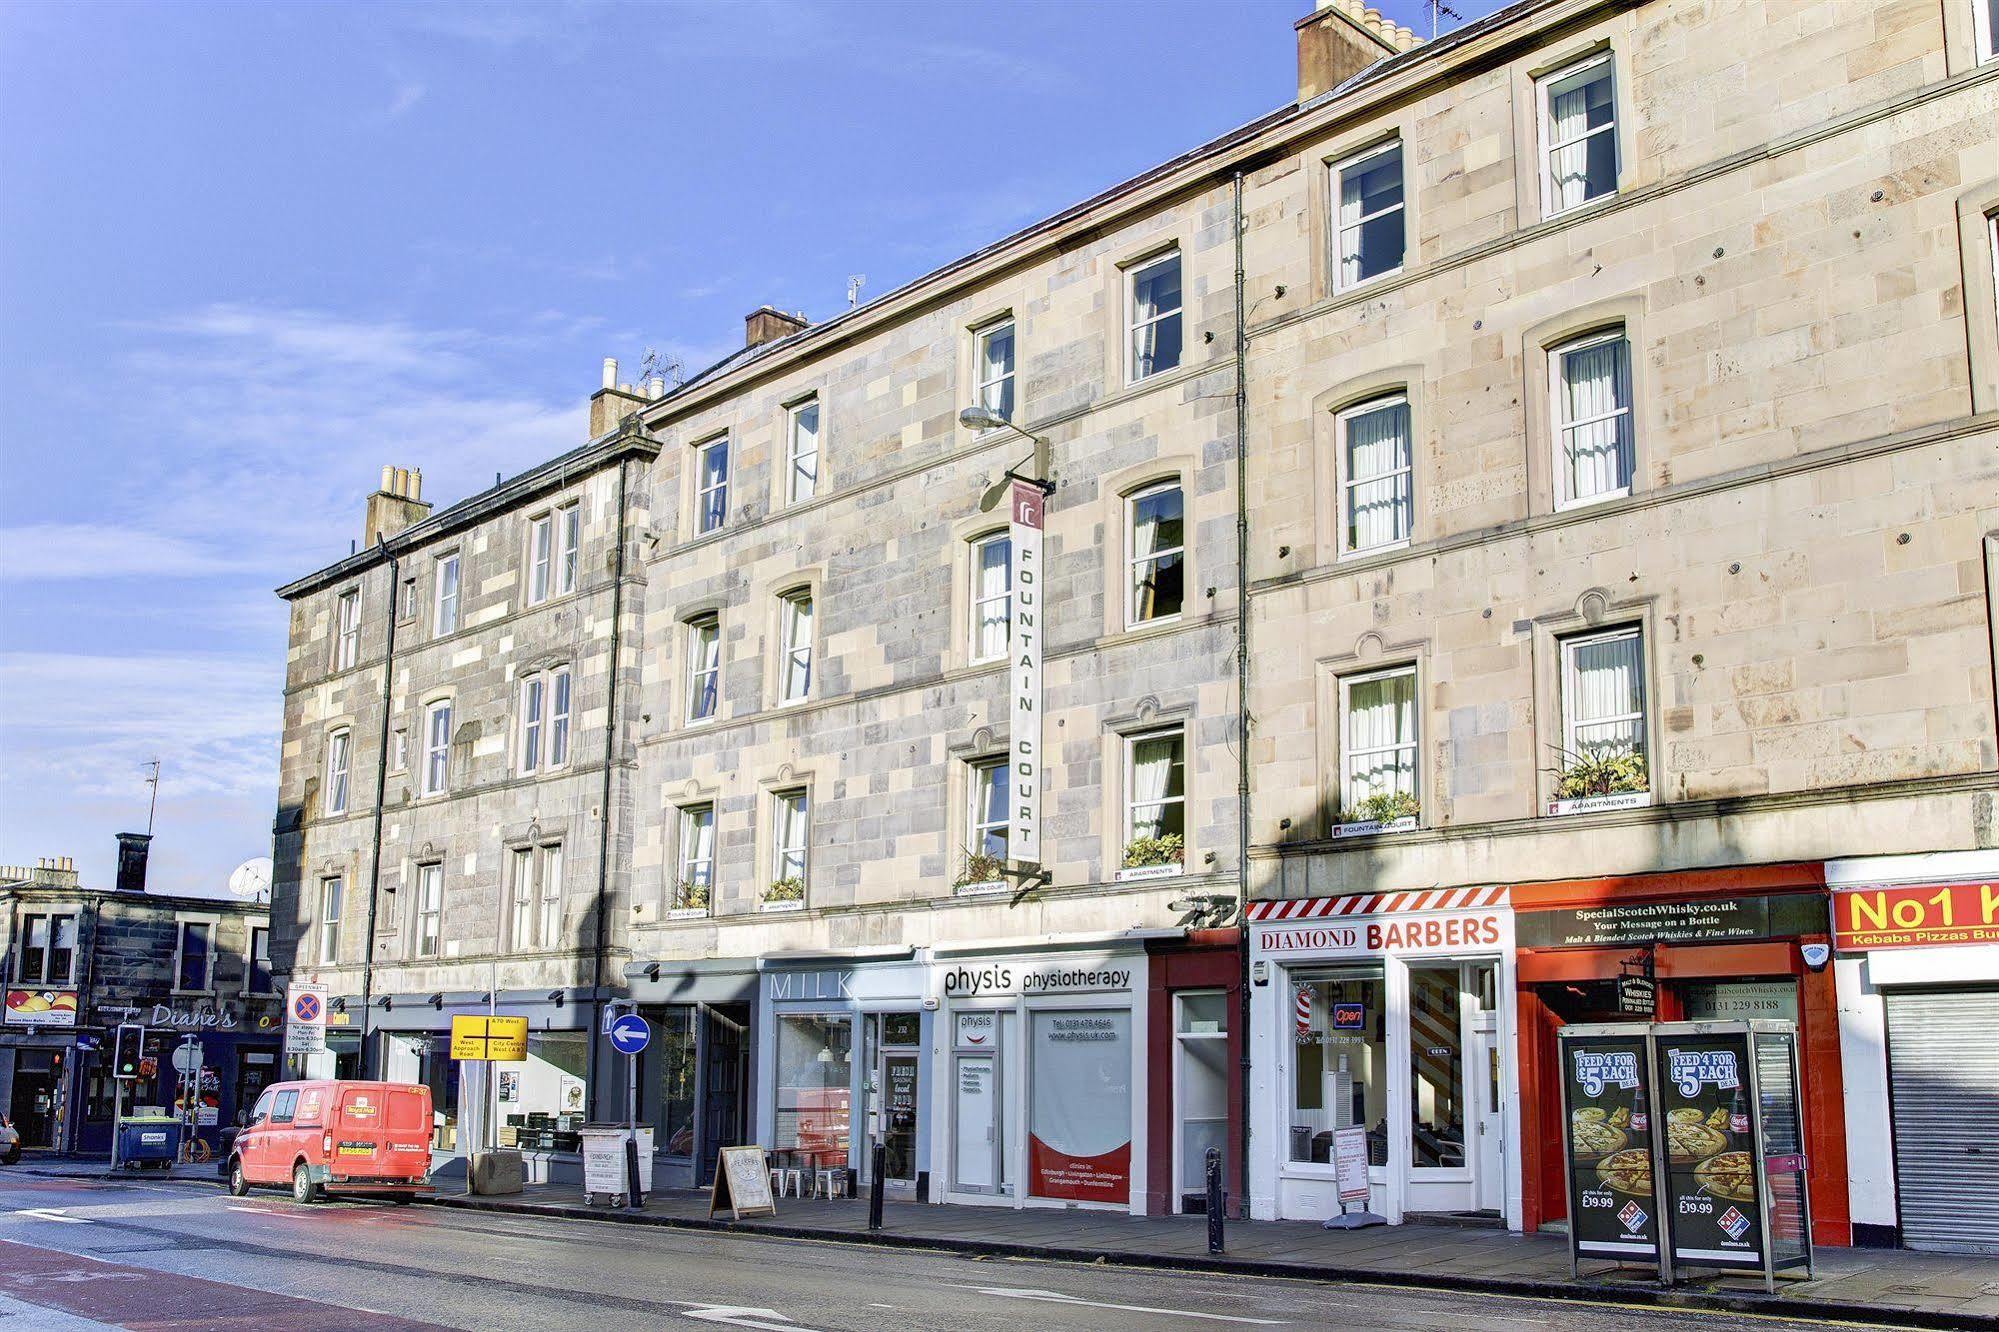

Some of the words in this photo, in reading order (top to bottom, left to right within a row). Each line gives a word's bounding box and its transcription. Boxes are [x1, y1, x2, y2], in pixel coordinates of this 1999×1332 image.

[1019, 549, 1034, 712] FOUNTAIN
[1019, 740, 1033, 842] COURT
[1571, 797, 1637, 811] APARTMENTS
[1129, 867, 1173, 878] APARTMENTS
[1576, 901, 1738, 920] SpecialScotchWhisky.co.uk
[1850, 887, 1953, 931] No1
[1593, 922, 1618, 931] Your
[1620, 919, 1662, 931] Message
[1689, 916, 1720, 925] Bottle
[1261, 930, 1356, 950] DIAMOND
[1367, 916, 1500, 950] BARBERS
[1565, 935, 1583, 944] Malt
[1584, 935, 1592, 943] &
[1594, 933, 1626, 943] Blended
[1628, 931, 1655, 940] Scotch
[1657, 930, 1693, 940] Whiskies
[1696, 929, 1702, 938] &
[1706, 928, 1726, 937] Fine
[1728, 927, 1754, 936] Wines
[1853, 934, 1912, 945] Kebabs
[1916, 931, 1969, 942] Pizzas
[771, 971, 853, 999] MILK
[945, 964, 1012, 996] physis
[1023, 969, 1130, 991] physiotherapy
[1705, 1001, 1728, 1011] 0131
[1733, 1001, 1751, 1010] 229
[1753, 1000, 1779, 1010] 8188
[152, 1003, 238, 1028] Diane's
[961, 1015, 991, 1028] physis
[1336, 1009, 1361, 1024] Open
[1578, 1055, 1602, 1067] FEED
[1605, 1055, 1612, 1066] 4
[1614, 1054, 1635, 1066] FOR
[1673, 1055, 1699, 1067] FEED
[1702, 1055, 1710, 1066] 4
[1712, 1054, 1734, 1066] FOR
[1579, 1066, 1602, 1096] £5
[1602, 1066, 1636, 1080] EACH
[1673, 1066, 1700, 1096] £5
[1698, 1066, 1735, 1080] EACH
[1040, 1168, 1065, 1176] Edinburgh
[1582, 1195, 1613, 1208] £19.99
[1679, 1201, 1713, 1214] £19.99
